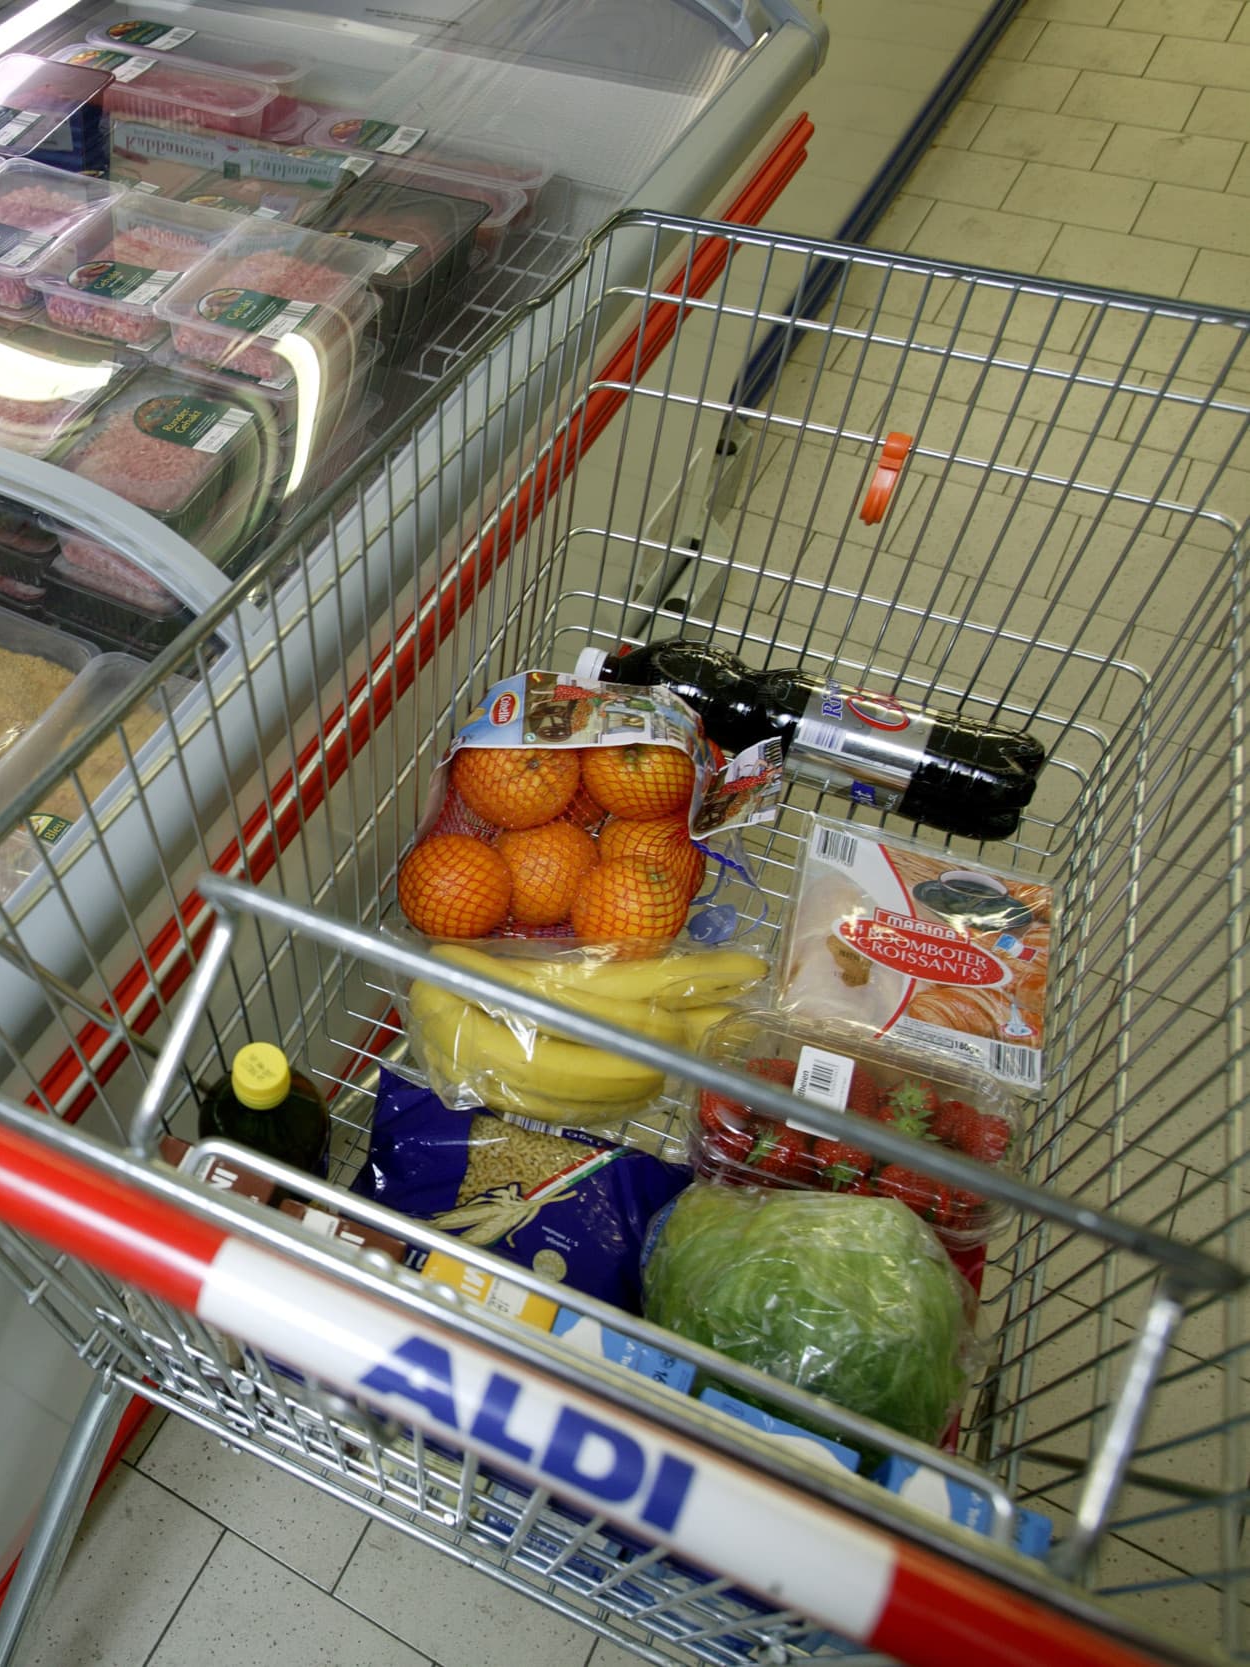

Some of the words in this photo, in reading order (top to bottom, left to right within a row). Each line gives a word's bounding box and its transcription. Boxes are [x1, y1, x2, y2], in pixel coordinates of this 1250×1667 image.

[44, 820, 67, 842] Bleu
[856, 935, 983, 981] CROISSANTS
[869, 924, 988, 970] ROOMBOTER
[356, 1334, 698, 1536] ALDI
